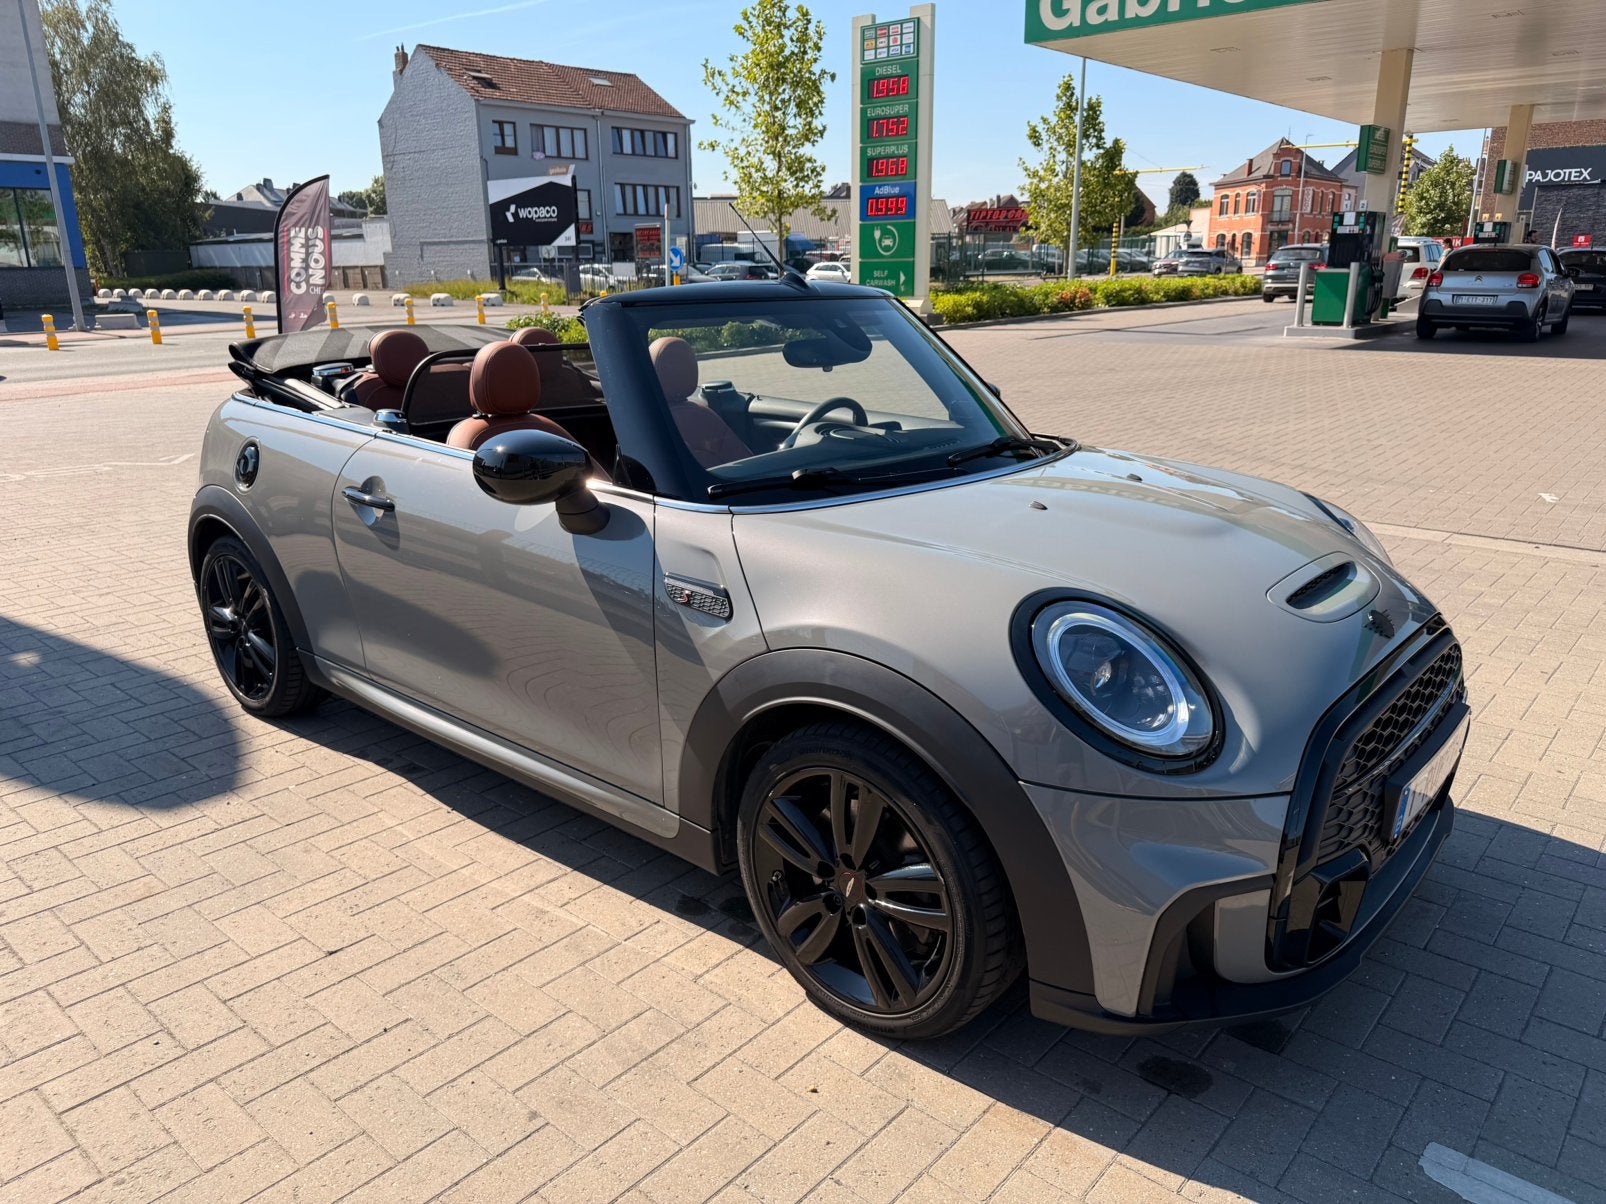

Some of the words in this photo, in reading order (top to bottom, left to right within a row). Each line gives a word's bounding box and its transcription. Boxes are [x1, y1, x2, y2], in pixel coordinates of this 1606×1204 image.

[1039, 0, 1247, 31] Gab
[875, 65, 902, 76] DIESEL
[873, 77, 909, 98] 1.958
[867, 104, 909, 117] EUROSUPER
[873, 117, 909, 138] 1.752
[867, 144, 909, 156] SUPERPLUS
[1525, 168, 1592, 182] PAJOTEX
[874, 185, 900, 195] AdBlue
[518, 206, 558, 220] wopaco
[290, 227, 307, 295] COMME
[308, 225, 326, 285] NOUS
[873, 270, 888, 278] SELF
[865, 279, 896, 287] CARWASH
